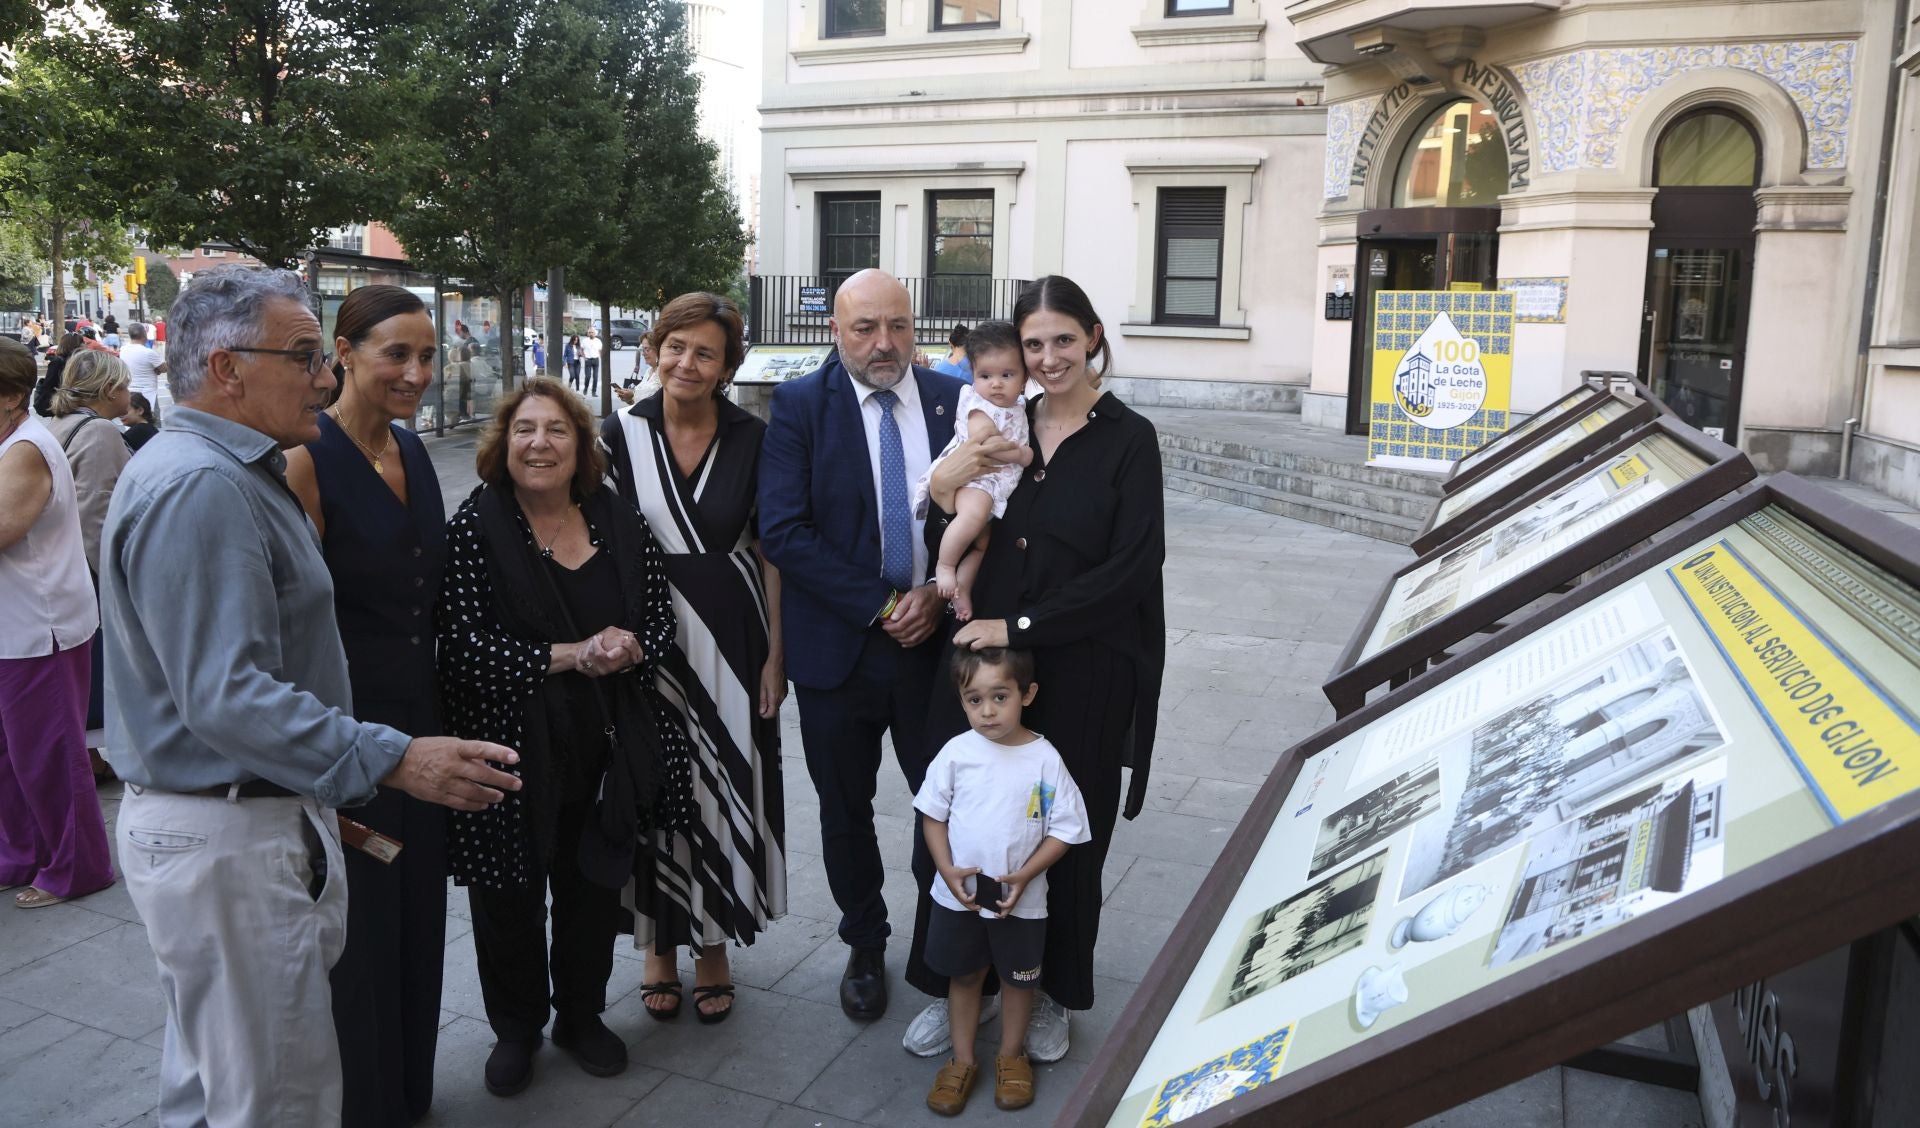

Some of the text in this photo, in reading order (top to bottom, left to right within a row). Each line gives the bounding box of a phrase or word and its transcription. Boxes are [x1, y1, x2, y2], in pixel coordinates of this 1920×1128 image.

[1433, 340, 1476, 362] 100
[1436, 364, 1480, 375] La Gota
[1434, 377, 1483, 388] de Leche
[1437, 402, 1477, 410] 1925-2025
[1694, 561, 1720, 584] UNA
[1741, 624, 1772, 645] AL
[1754, 636, 1822, 700] SERVICIO
[1798, 693, 1844, 725] DE
